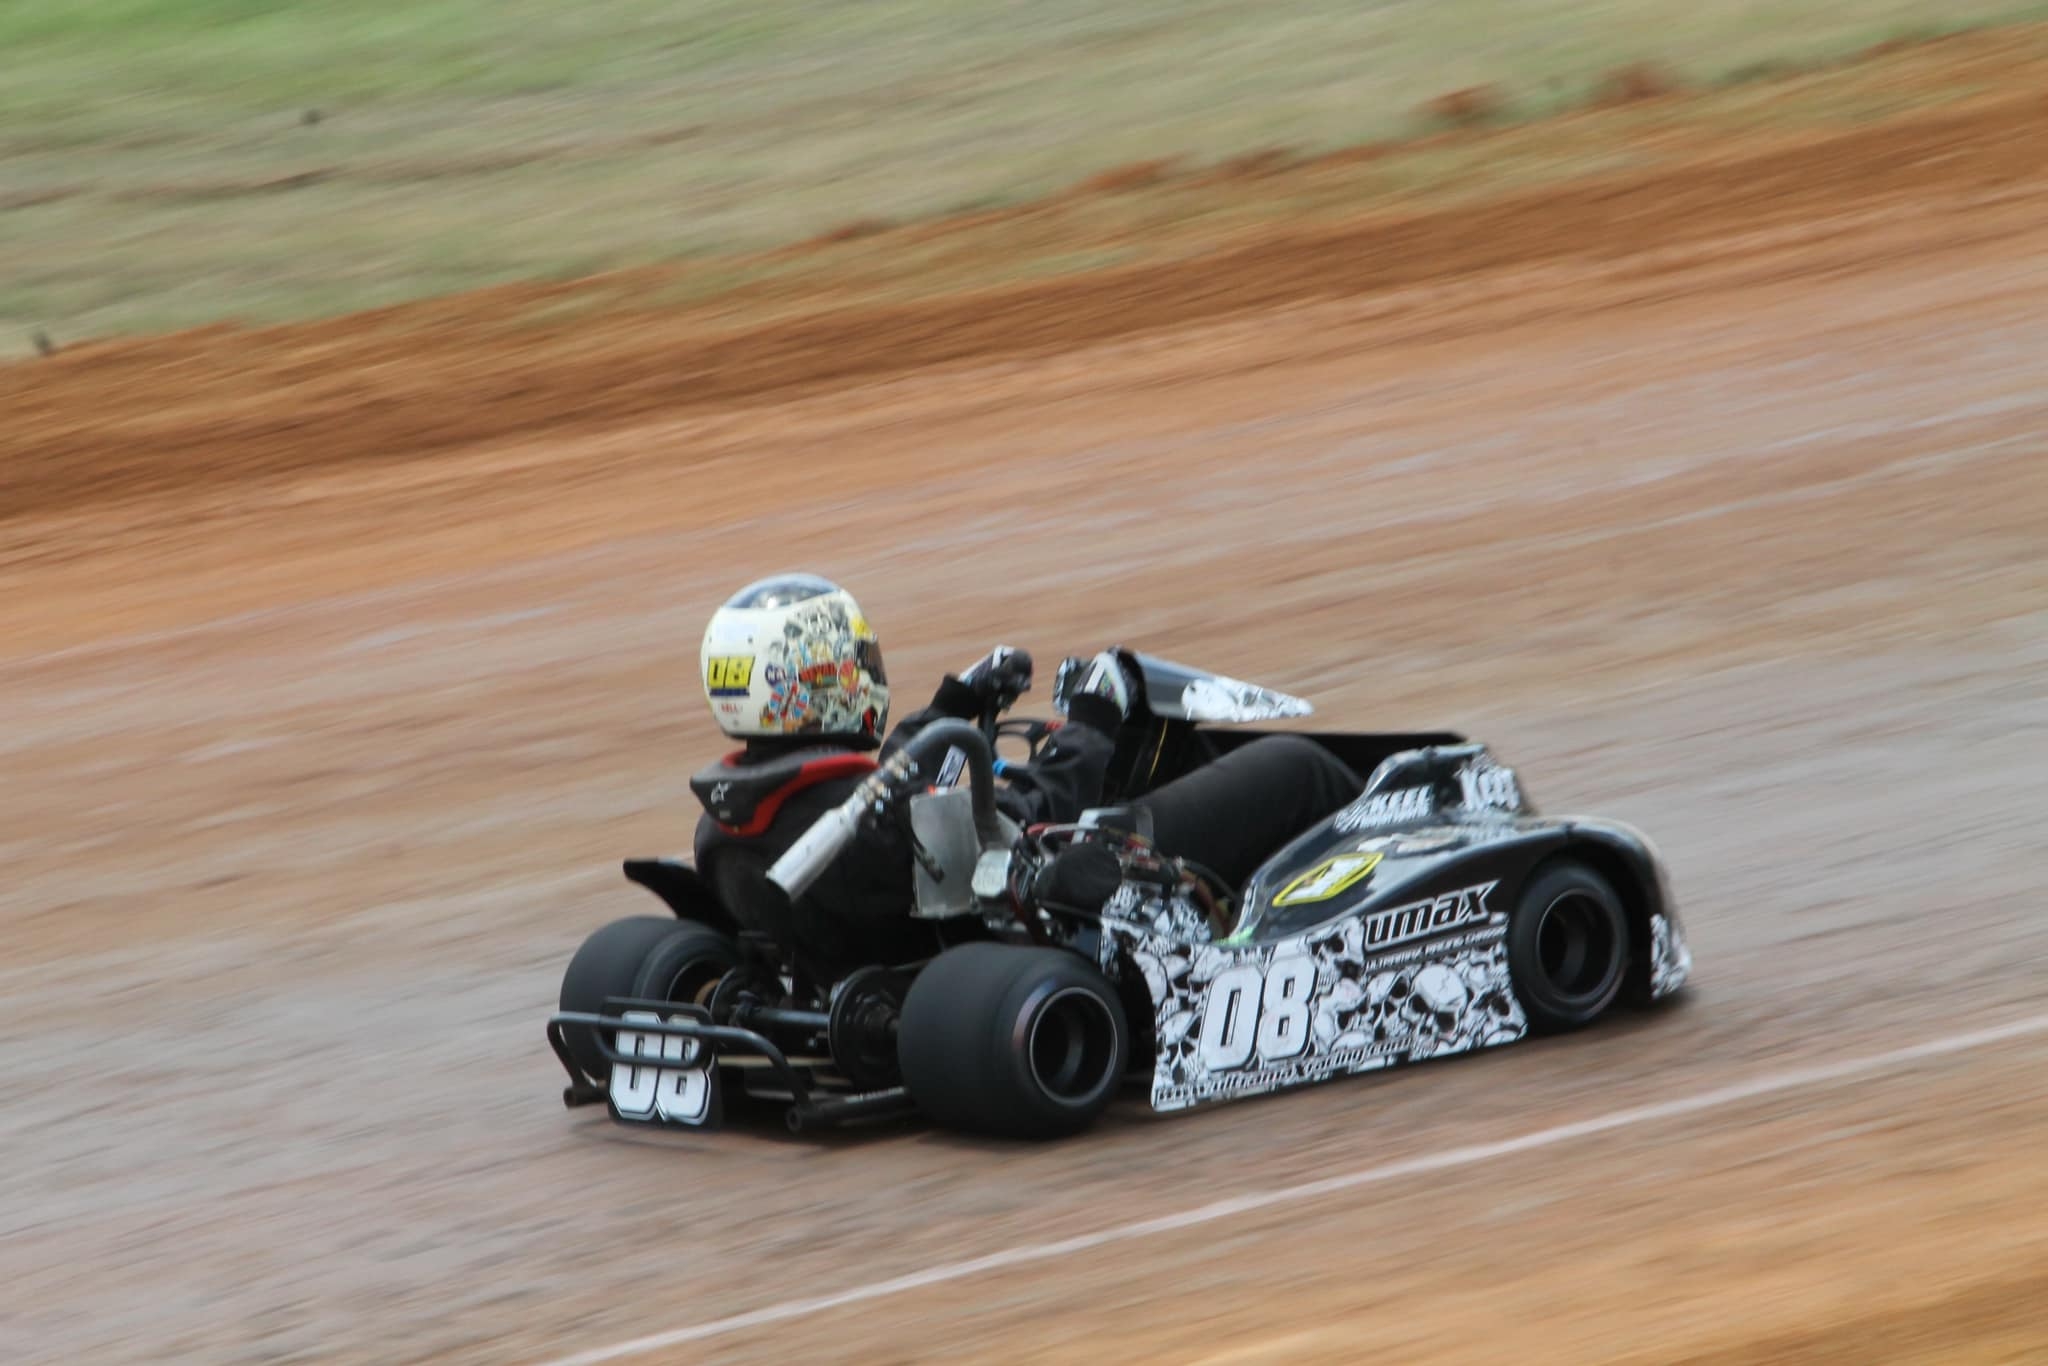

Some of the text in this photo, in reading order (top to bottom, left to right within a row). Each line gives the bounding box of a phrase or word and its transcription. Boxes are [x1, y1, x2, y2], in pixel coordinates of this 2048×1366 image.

[708, 656, 755, 688] 08
[1365, 881, 1499, 949] umax
[1199, 953, 1319, 1072] 08
[610, 1011, 711, 1126] 08
